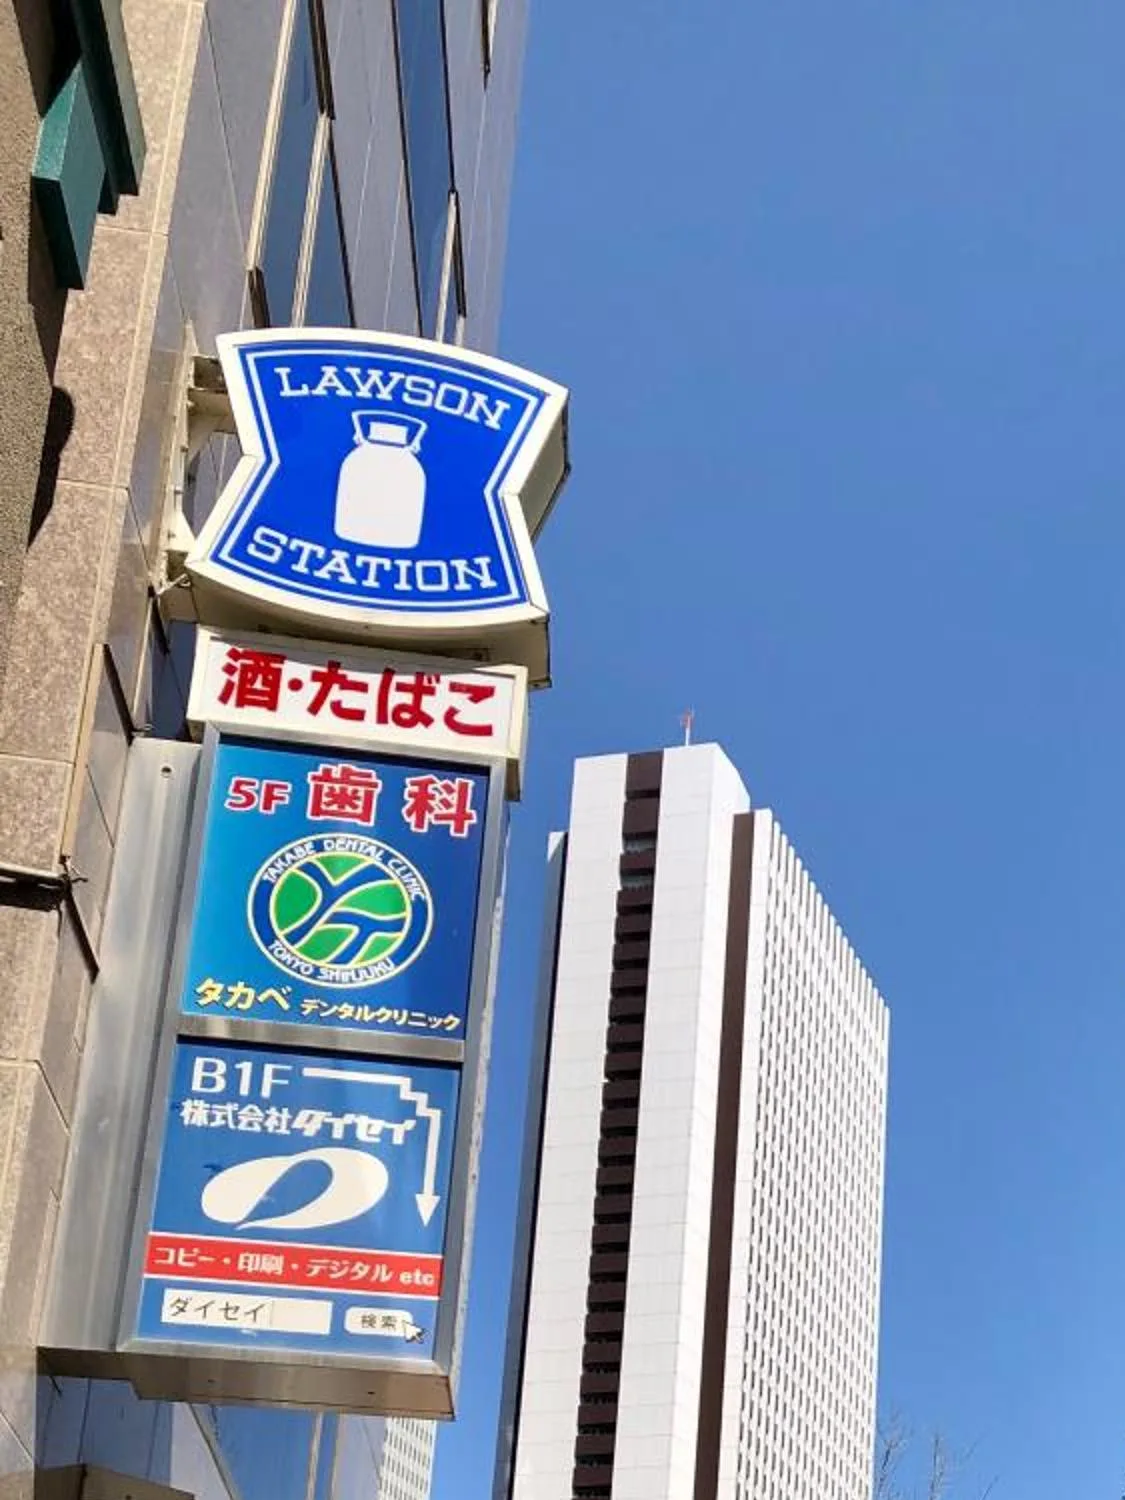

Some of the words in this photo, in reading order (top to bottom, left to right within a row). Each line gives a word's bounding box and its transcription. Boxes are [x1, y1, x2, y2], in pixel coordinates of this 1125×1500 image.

[274, 365, 511, 431] LAWSON
[246, 525, 499, 593] STATION
[217, 646, 497, 737] 酒・たばこ
[225, 776, 292, 814] 5F
[307, 763, 477, 837] 歯科
[262, 840, 316, 884] TAKABE
[323, 838, 385, 862] DENTAL
[387, 857, 427, 902] CLINIC
[267, 939, 314, 976] TOKYO
[317, 956, 396, 983] SHINJUKU
[195, 977, 293, 1012] タカベ
[299, 997, 462, 1032] デンタルクリニック
[190, 1056, 294, 1099] B1F
[179, 1098, 417, 1146] 株式会社ダイセイ
[399, 1271, 436, 1287] etc
[168, 1295, 267, 1324] ダイセイ
[360, 1313, 398, 1331] 検索
